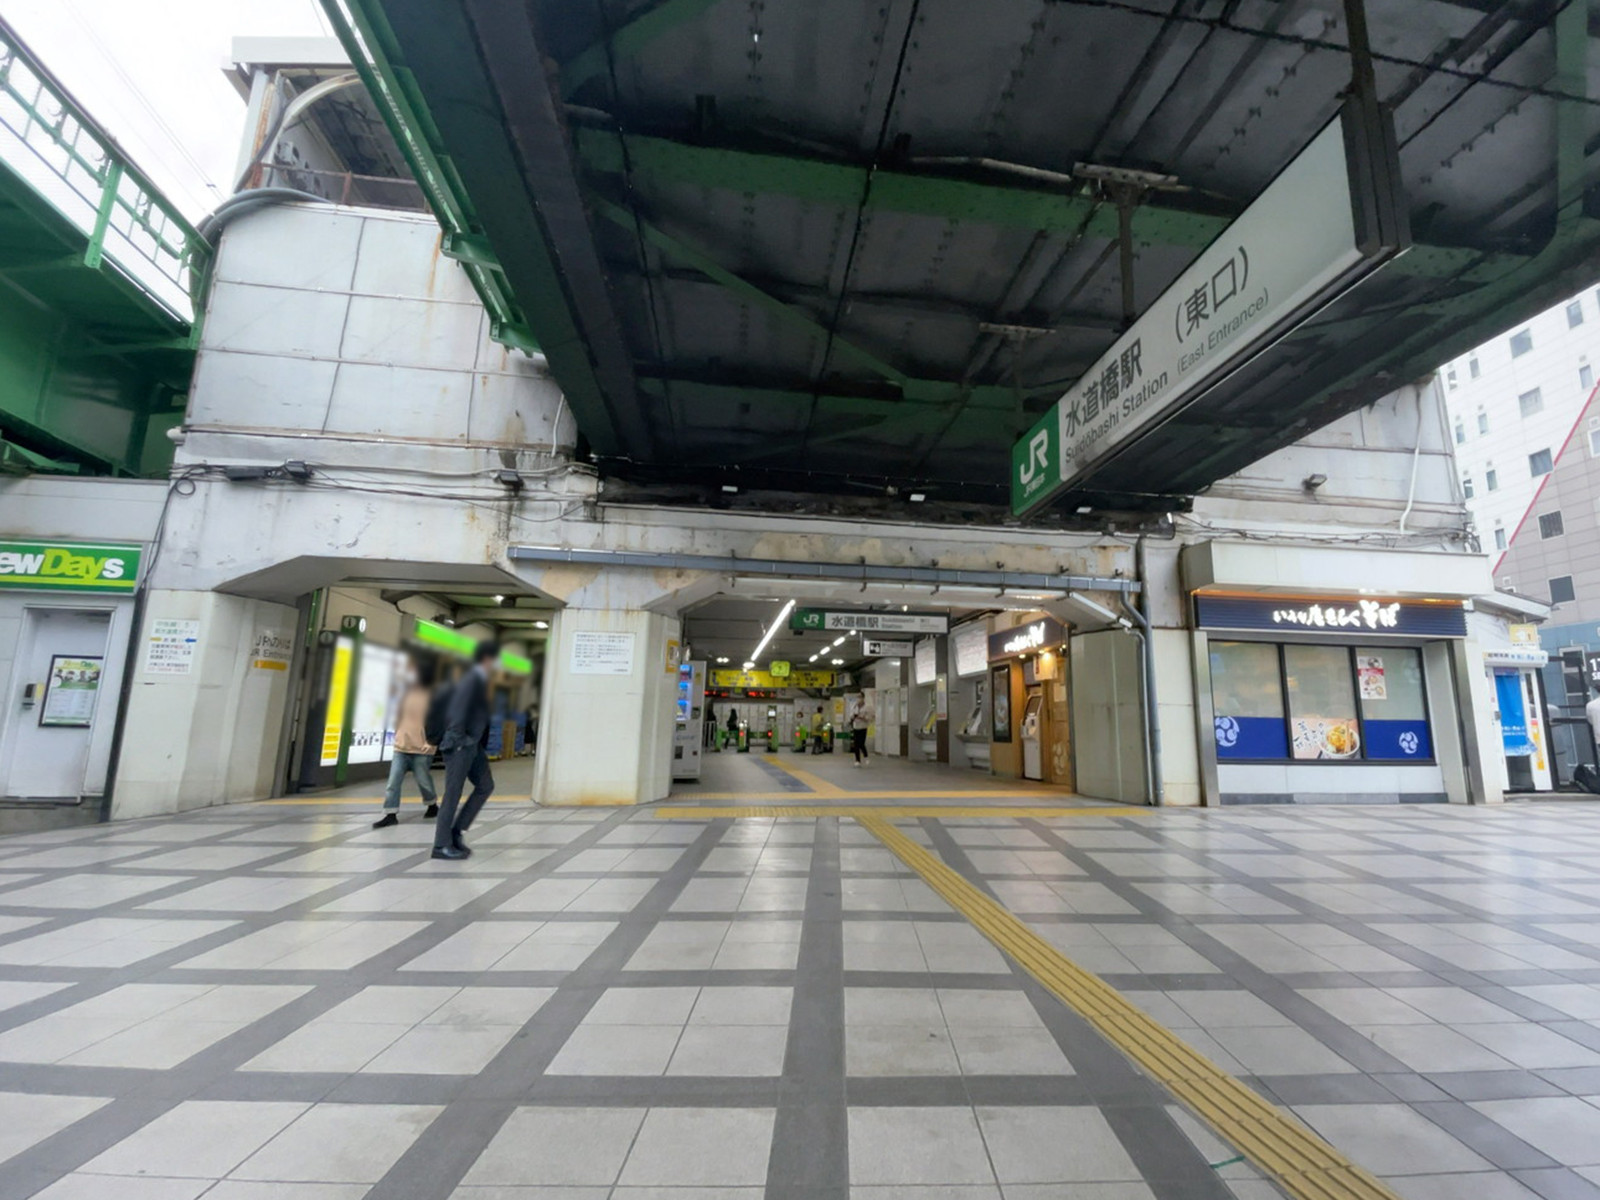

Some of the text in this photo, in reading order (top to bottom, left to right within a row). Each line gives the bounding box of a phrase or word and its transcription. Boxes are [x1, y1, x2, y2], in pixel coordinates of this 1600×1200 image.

[1122, 371, 1168, 418] Station
[1177, 342, 1205, 376] (East
[1208, 287, 1268, 351] Entrance)
[1065, 336, 1143, 439] 水道橋駅
[1019, 428, 1048, 486] JR
[803, 613, 820, 624] JR
[831, 615, 880, 629] 水道橋駅
